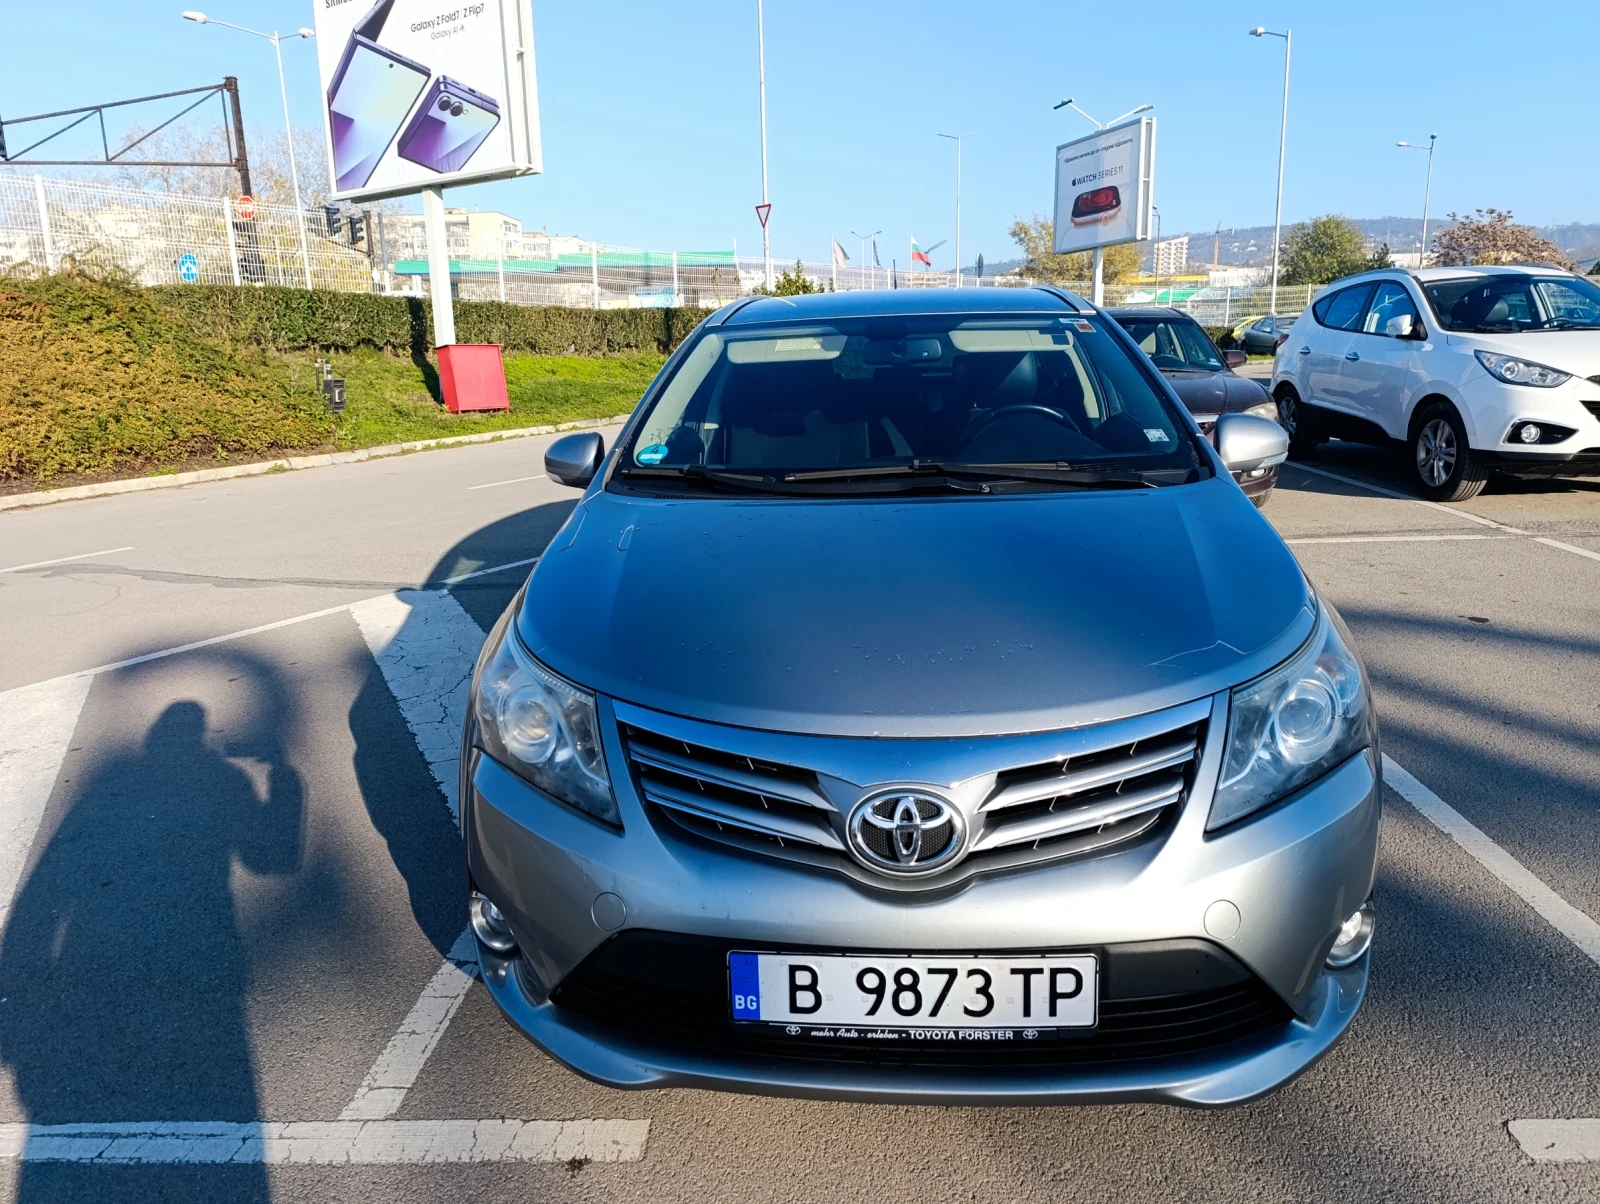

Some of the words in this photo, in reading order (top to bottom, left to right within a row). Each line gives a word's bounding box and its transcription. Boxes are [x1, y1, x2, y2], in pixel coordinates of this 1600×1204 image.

[411, 19, 435, 32] Galaxy
[436, 16, 441, 25] Z
[441, 10, 460, 24] Fold7
[463, 8, 468, 18] Z
[469, 3, 484, 17] Flip7
[431, 29, 451, 40] Galaxy
[1077, 173, 1097, 185] WATCH
[1098, 167, 1118, 180] SERIES
[788, 964, 822, 1014] B
[856, 967, 995, 1017] 9873
[1010, 967, 1084, 1018] TP
[735, 995, 757, 1010] BG
[811, 1028, 834, 1037] mehr
[837, 1028, 858, 1038] Auto
[867, 1029, 899, 1039] erleben
[909, 1030, 956, 1040] TOYOTA
[959, 1029, 1013, 1040] FÖRSTER
